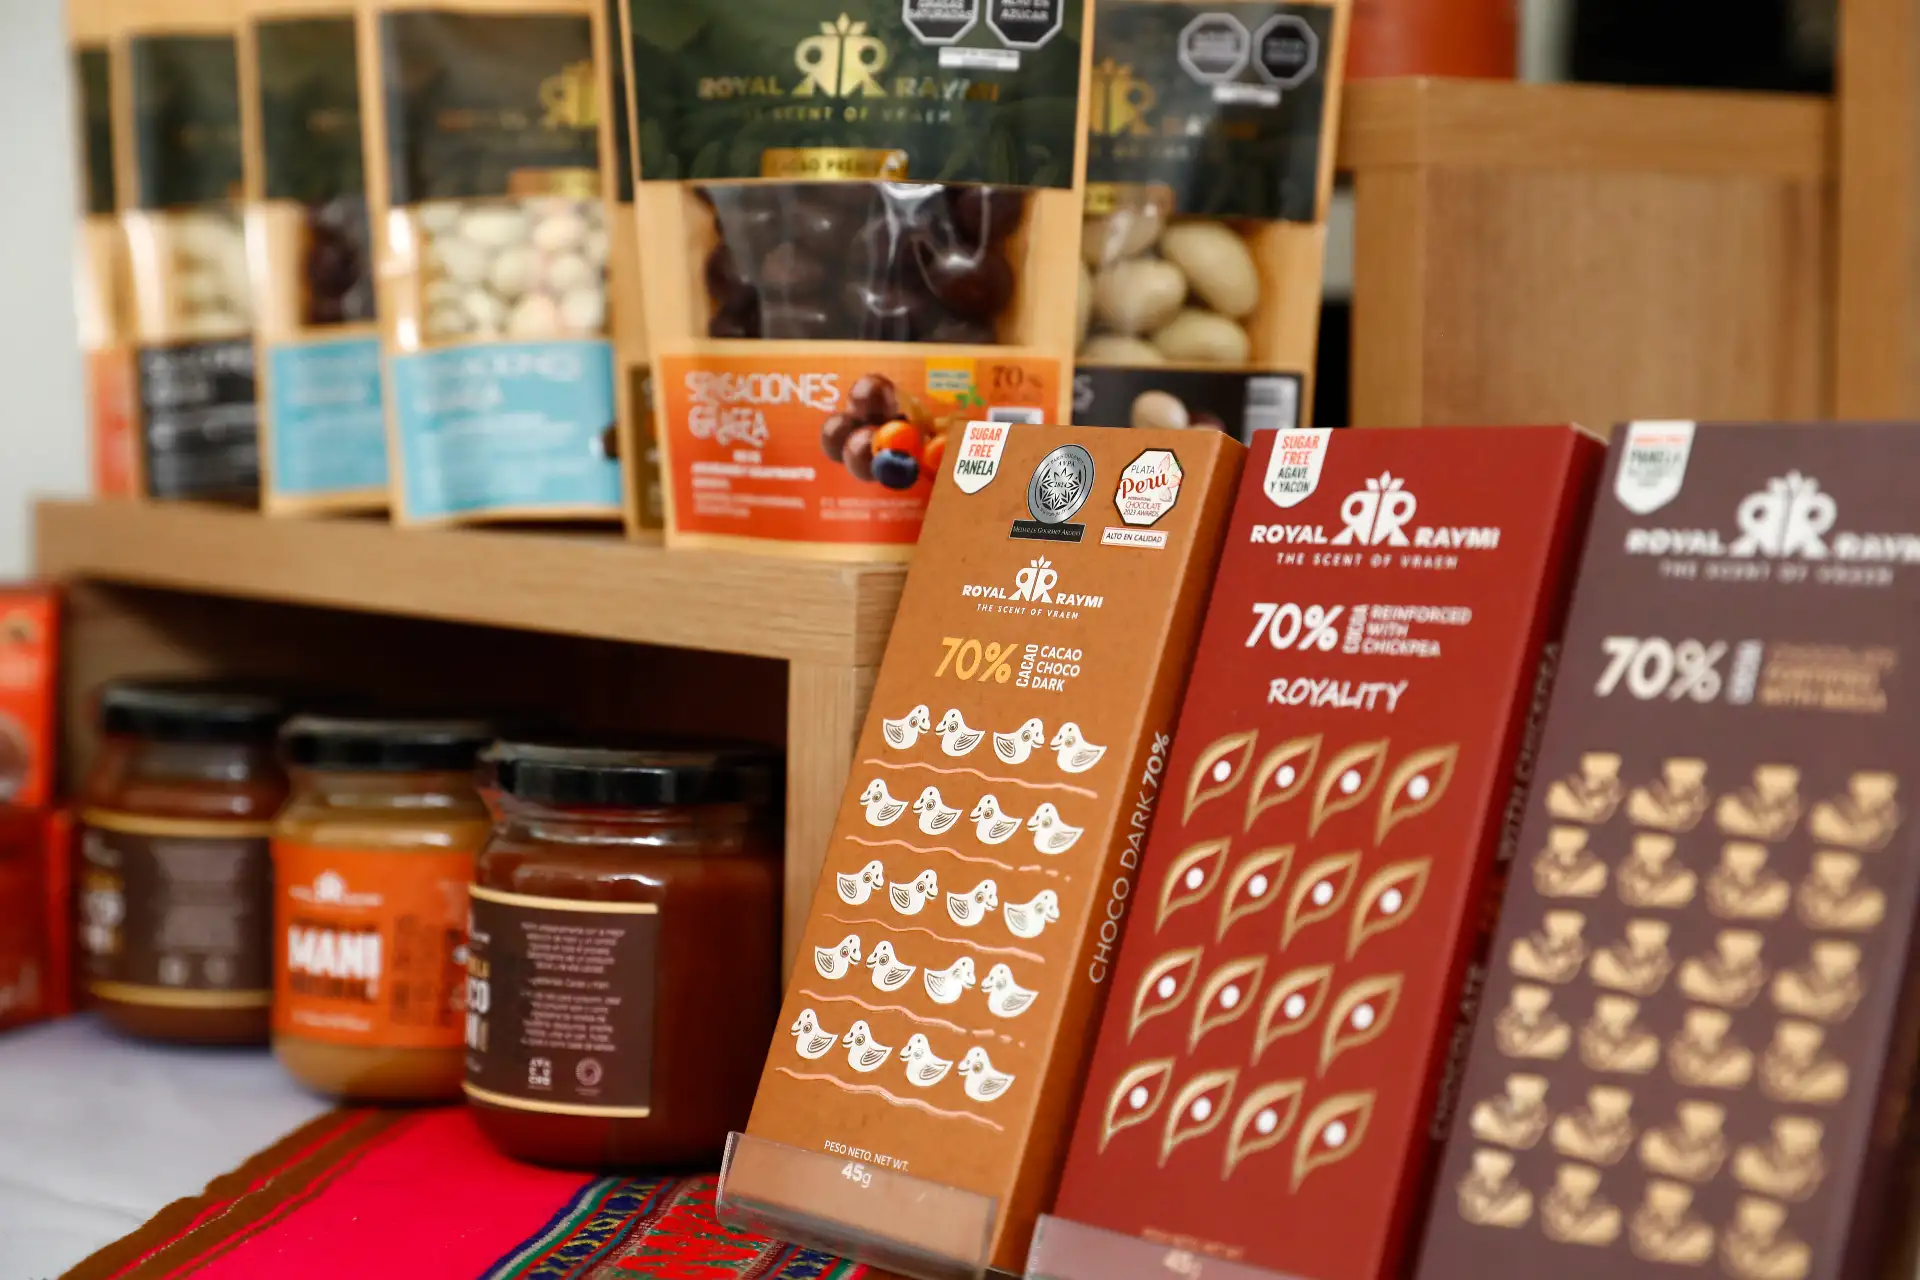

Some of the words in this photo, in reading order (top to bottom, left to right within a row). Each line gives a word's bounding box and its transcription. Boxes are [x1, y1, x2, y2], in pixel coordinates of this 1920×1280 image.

[970, 428, 1002, 441] SUGAR
[1282, 435, 1320, 449] SUGAR
[967, 444, 995, 458] FREE
[1281, 451, 1312, 465] FREE
[957, 460, 994, 475] PANELA
[1130, 464, 1155, 474] PLATA
[1277, 467, 1308, 478] AGAVE
[1118, 470, 1168, 499] Perú
[1125, 500, 1161, 510] CHOCOLATE
[1106, 532, 1122, 540] ALTO
[1123, 533, 1132, 541] EN
[1134, 534, 1162, 543] CALIDAD
[1250, 524, 1328, 545] ROYAL
[1413, 526, 1501, 549] RAYMI
[1277, 552, 1305, 566] THE
[1313, 553, 1363, 567] SCENT
[1370, 554, 1392, 568] OF
[1400, 554, 1458, 570] VRAEM
[962, 585, 1006, 600] ROYAL
[1055, 593, 1103, 608] RAYMI
[977, 603, 993, 612] THE
[997, 605, 1025, 615] SCENT
[1030, 608, 1042, 616] OF
[1047, 609, 1079, 619] VRAEM
[1245, 602, 1346, 651] 70%
[1366, 620, 1410, 637] WITH
[934, 637, 1019, 683] 70%
[1040, 646, 1082, 661] CACAO
[1016, 644, 1038, 688] CACAO
[1036, 661, 1080, 677] CHOCO
[1595, 636, 1729, 703] 70%
[1031, 676, 1065, 692] DARK
[1267, 677, 1409, 714] ROYALITY
[1088, 877, 1130, 984] CHOCO
[1120, 790, 1154, 870] DARK
[1142, 731, 1170, 788] 70%
[824, 1140, 846, 1154] PESO
[873, 1153, 892, 1167] NET
[841, 1161, 872, 1188] 45g
